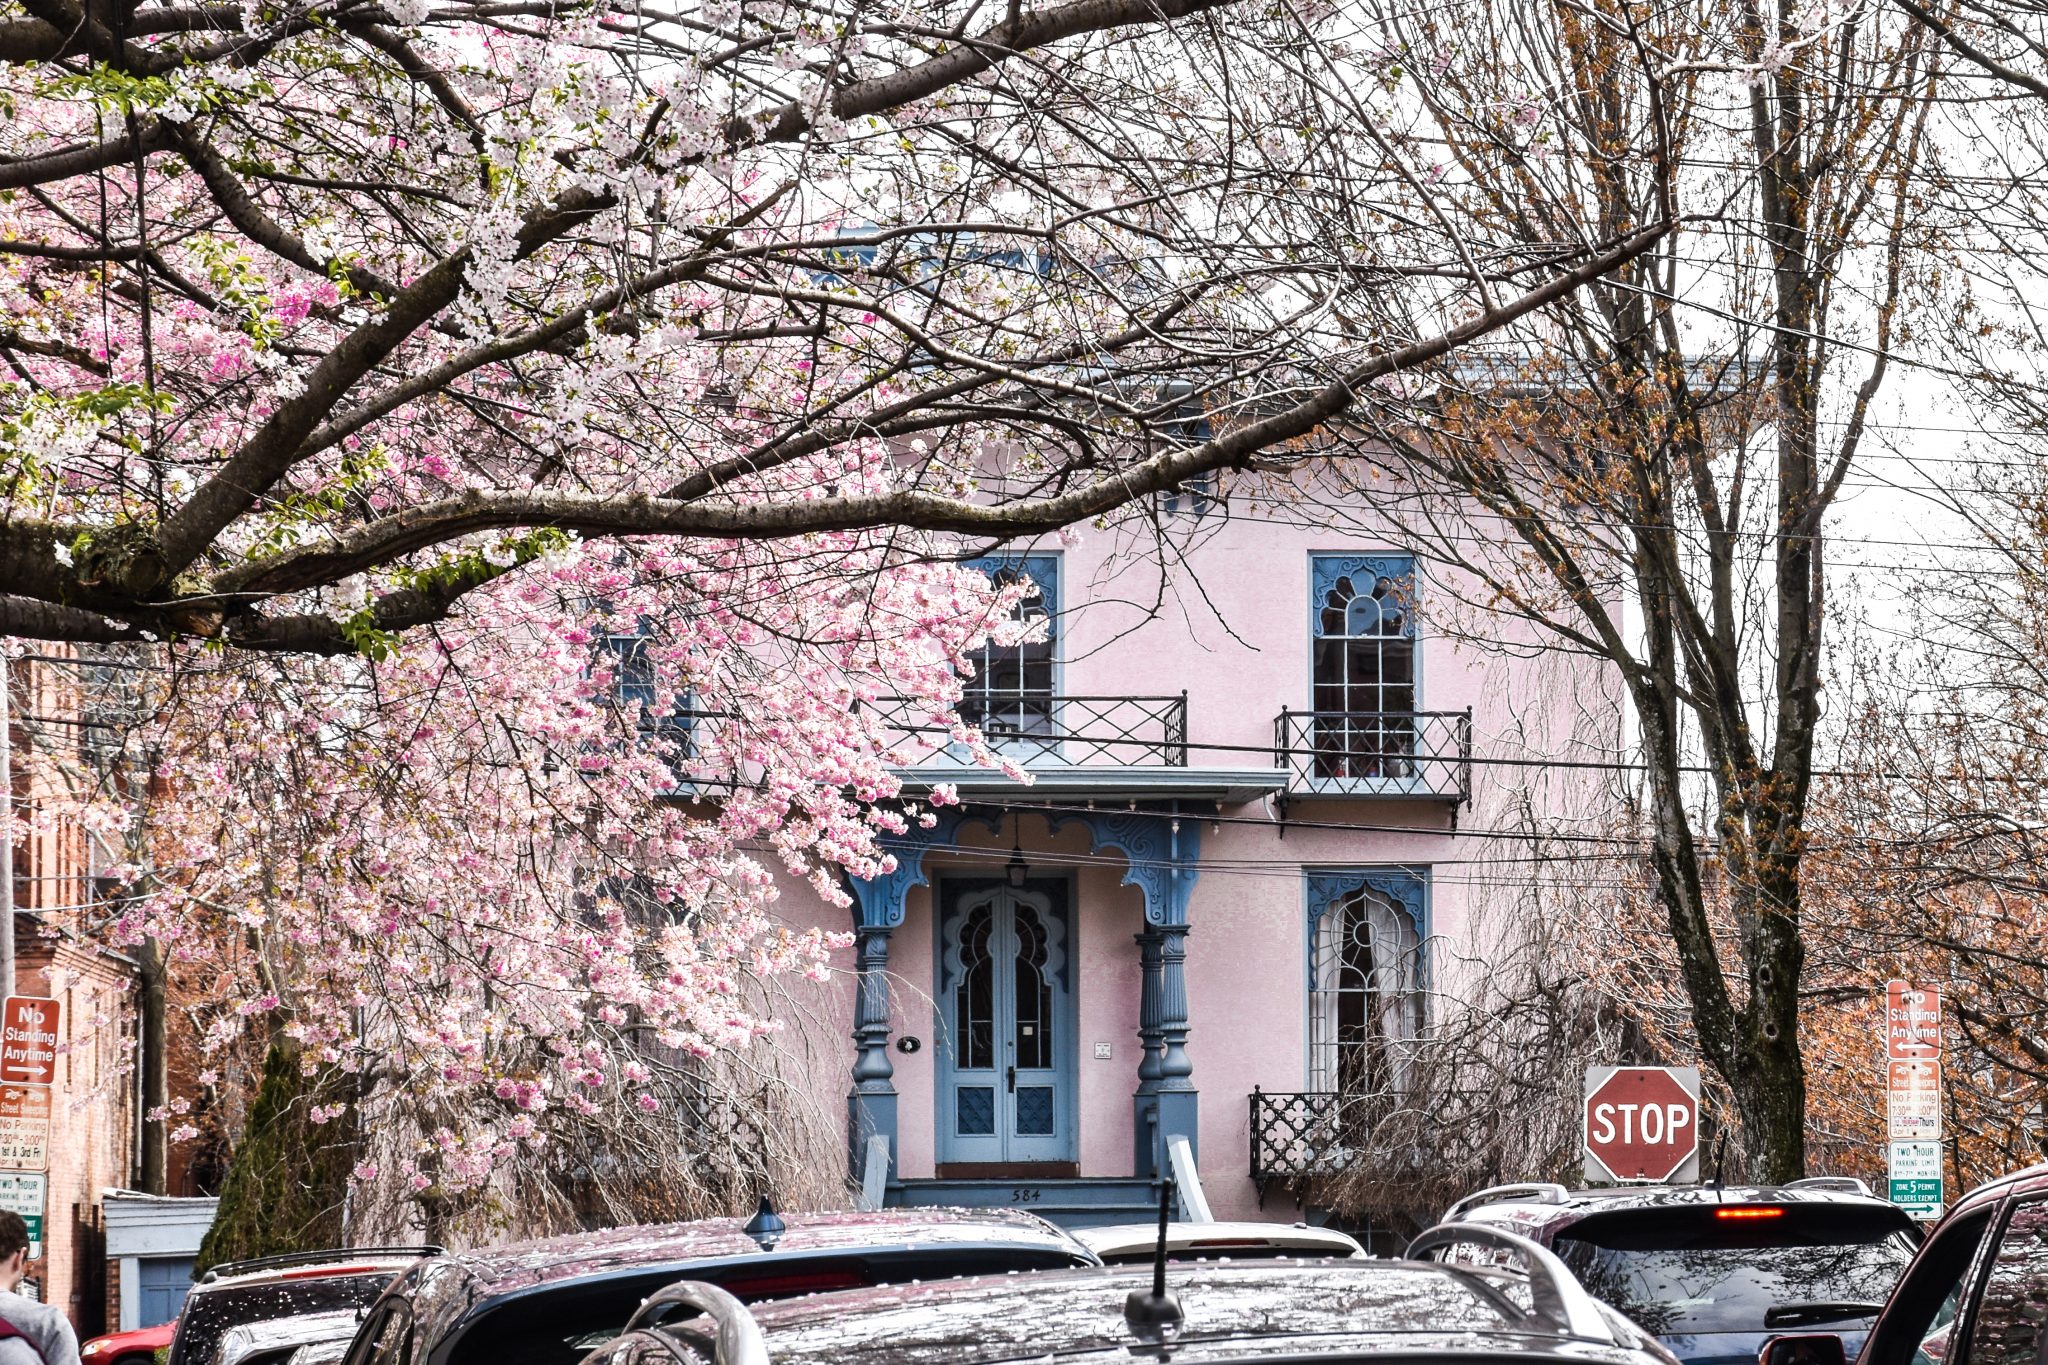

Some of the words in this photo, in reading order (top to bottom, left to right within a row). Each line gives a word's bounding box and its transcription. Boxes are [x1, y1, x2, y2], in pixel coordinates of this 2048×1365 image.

[18, 1006, 45, 1024] No
[1890, 1008, 1937, 1024] Standing
[6, 1026, 55, 1046] Standing
[4, 1046, 54, 1062] Anytime
[1892, 1093, 1904, 1102] No
[0, 1102, 18, 1114] Street
[1593, 1103, 1690, 1145] STOP
[1897, 1148, 1911, 1157] TWO
[1917, 1148, 1934, 1157] HOUR
[1896, 1159, 1917, 1167] PARKING
[18, 1180, 38, 1190] HOUR
[1896, 1183, 1909, 1191] ZONE
[1910, 1180, 1917, 1193] 5
[1918, 1183, 1936, 1191] PERMIT
[1012, 1189, 1041, 1202] 584
[1894, 1194, 1916, 1202] HOLDERS
